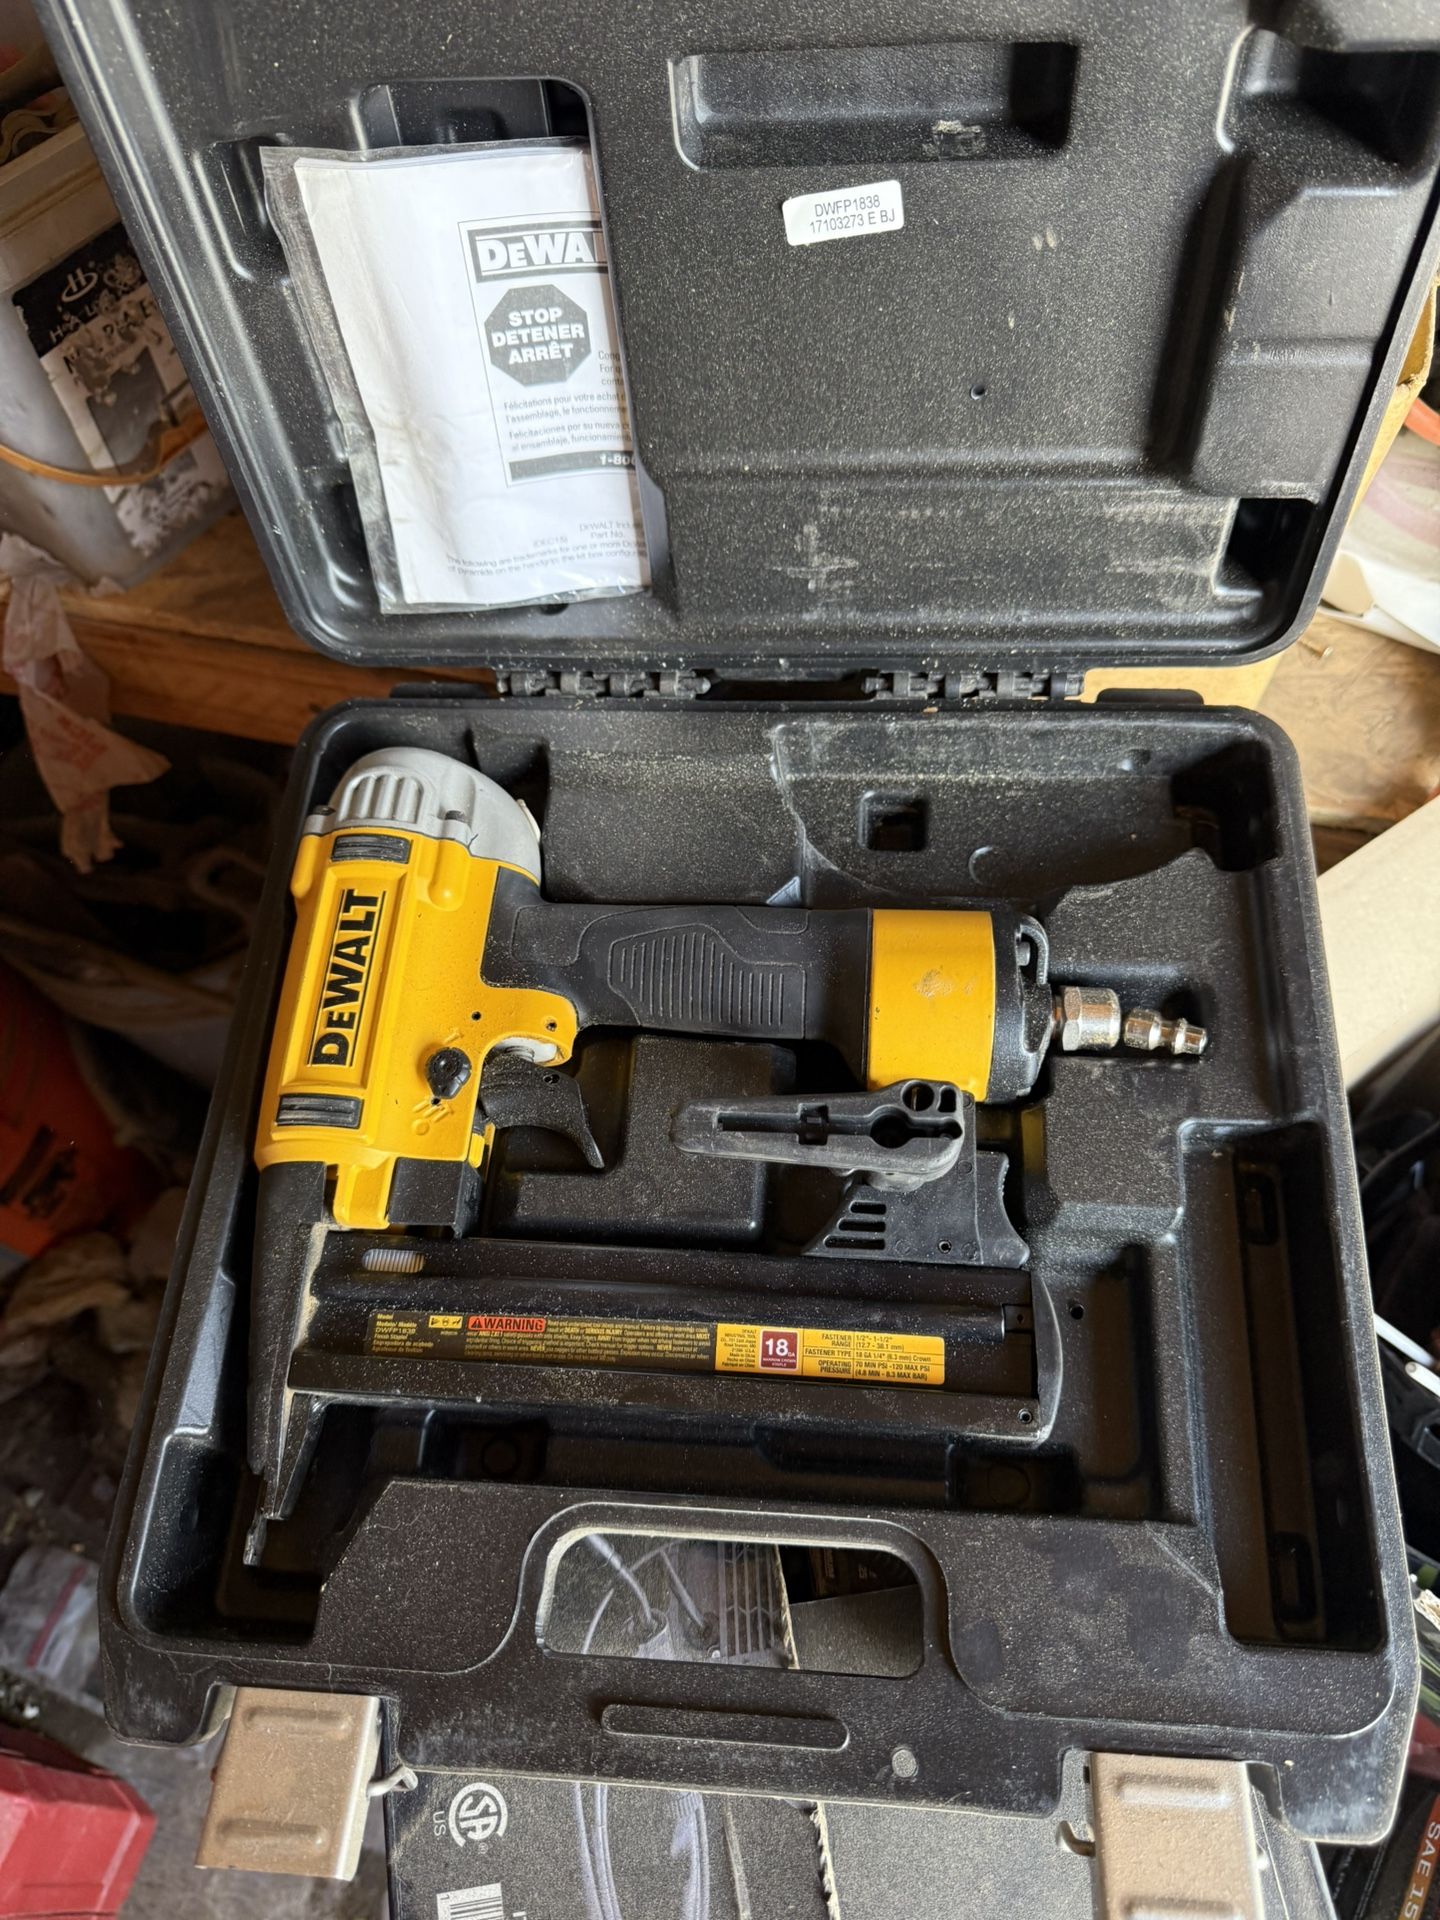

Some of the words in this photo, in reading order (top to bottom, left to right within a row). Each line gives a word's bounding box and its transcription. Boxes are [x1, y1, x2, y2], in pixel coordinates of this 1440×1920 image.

[815, 194, 881, 217] DWFP1838
[809, 214, 865, 234] 17103273
[868, 211, 877, 225] E
[880, 208, 896, 223] BJ
[508, 307, 562, 327] STOP
[491, 323, 585, 347] DETENER
[509, 342, 574, 365] ARRÊT
[574, 393, 595, 402] votre
[313, 887, 381, 1067] DEWALT
[484, 1318, 543, 1331] WARNING
[822, 1333, 852, 1341] FASTENER
[831, 1340, 851, 1348] RANGE
[766, 1338, 789, 1356] 18
[805, 1348, 836, 1356] FASTENER
[837, 1350, 852, 1358] TYPE
[818, 1360, 852, 1368] OPERATING
[820, 1366, 852, 1375] PRESSURE
[864, 1361, 876, 1369] MIN
[904, 1364, 919, 1372] MAX
[920, 1364, 930, 1372] PSI
[868, 1369, 880, 1377] MIN
[897, 1371, 911, 1379] MAX
[912, 1372, 928, 1381] BAR)
[433, 1811, 446, 1836] US
[1417, 1821, 1440, 1877] SAE
